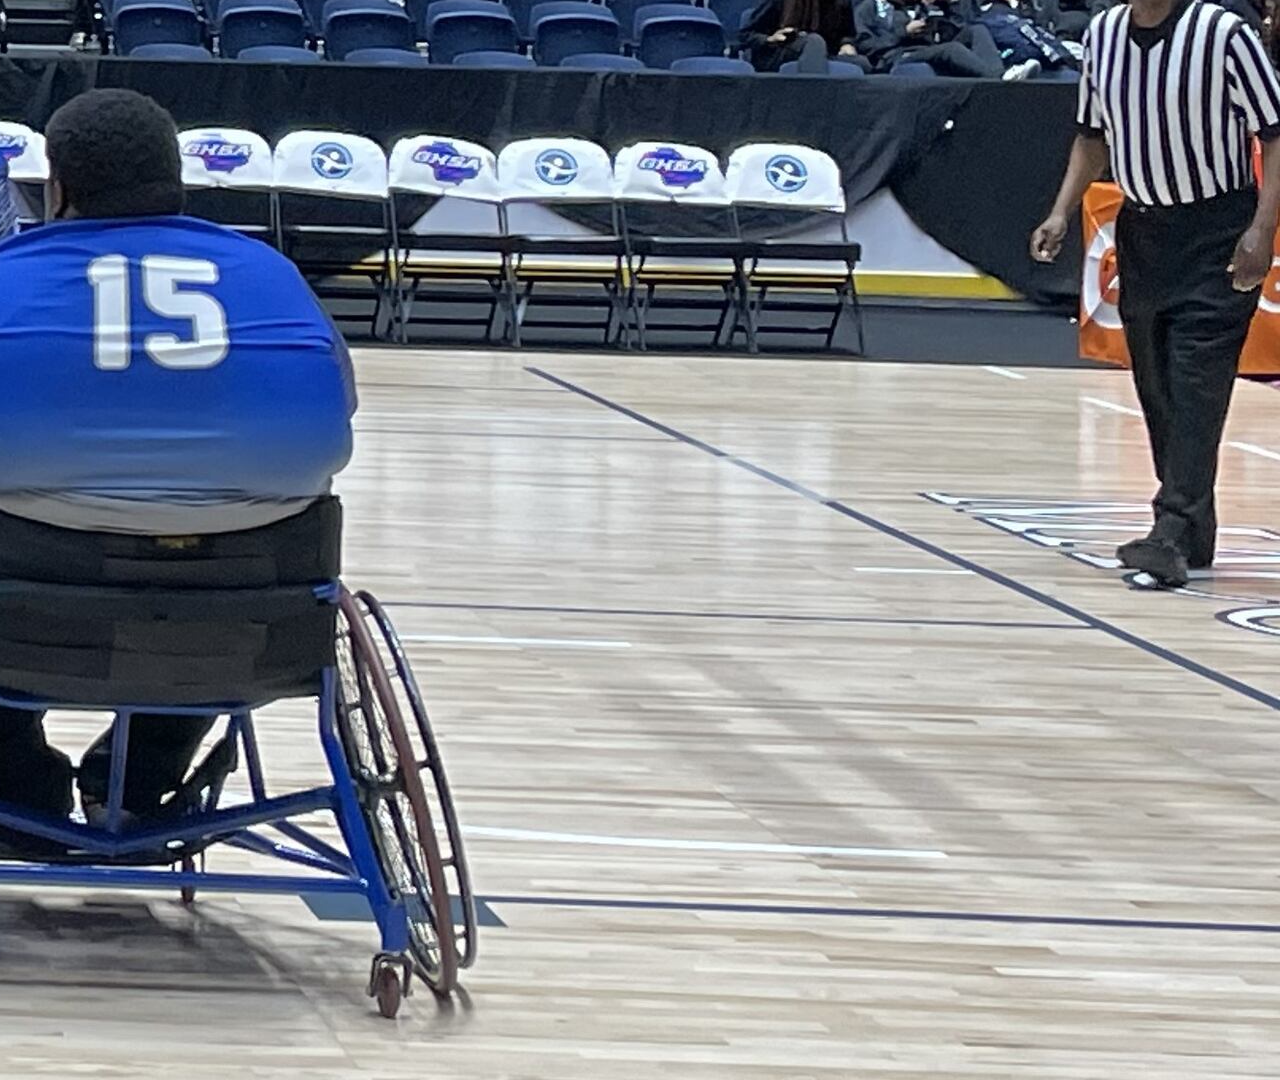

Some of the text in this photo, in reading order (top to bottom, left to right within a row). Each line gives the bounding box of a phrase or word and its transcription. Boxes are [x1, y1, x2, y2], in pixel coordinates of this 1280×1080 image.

[182, 143, 252, 157] GHSA
[413, 150, 482, 171] GHSA
[639, 157, 708, 173] GHSA
[86, 253, 231, 372] 15
